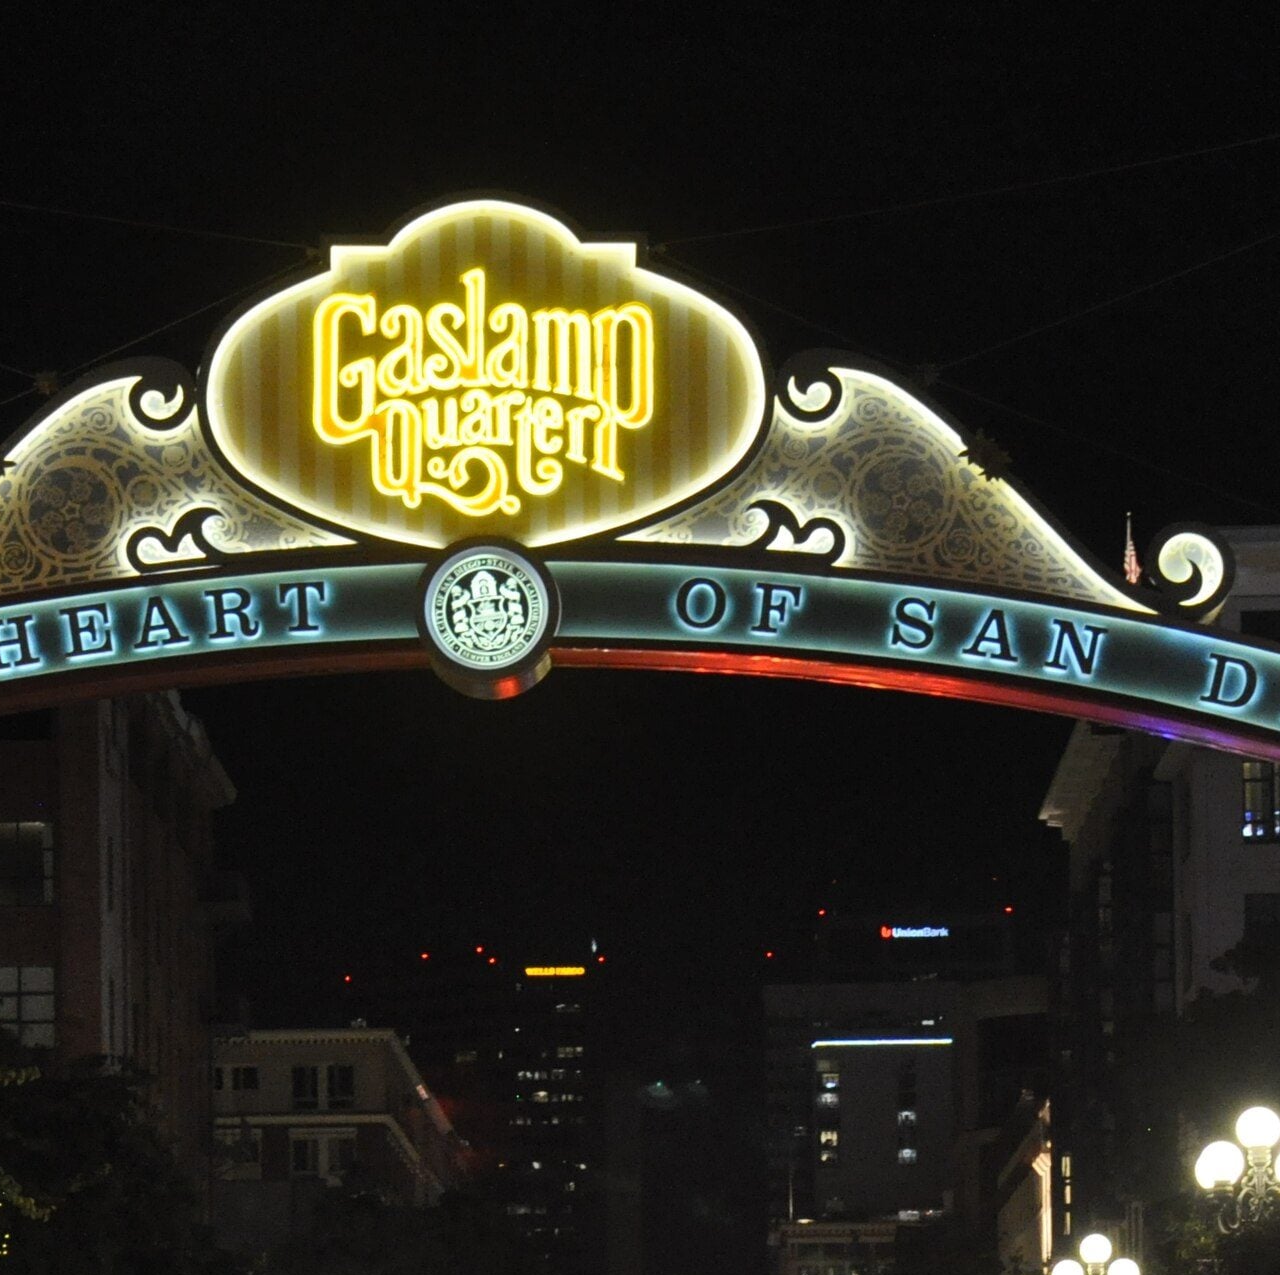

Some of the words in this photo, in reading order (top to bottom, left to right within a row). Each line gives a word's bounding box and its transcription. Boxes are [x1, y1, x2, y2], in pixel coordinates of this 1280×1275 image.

[312, 266, 655, 446] Gaslamp
[370, 388, 626, 518] Quarter
[674, 576, 803, 635] OF
[890, 596, 1110, 676] SAN
